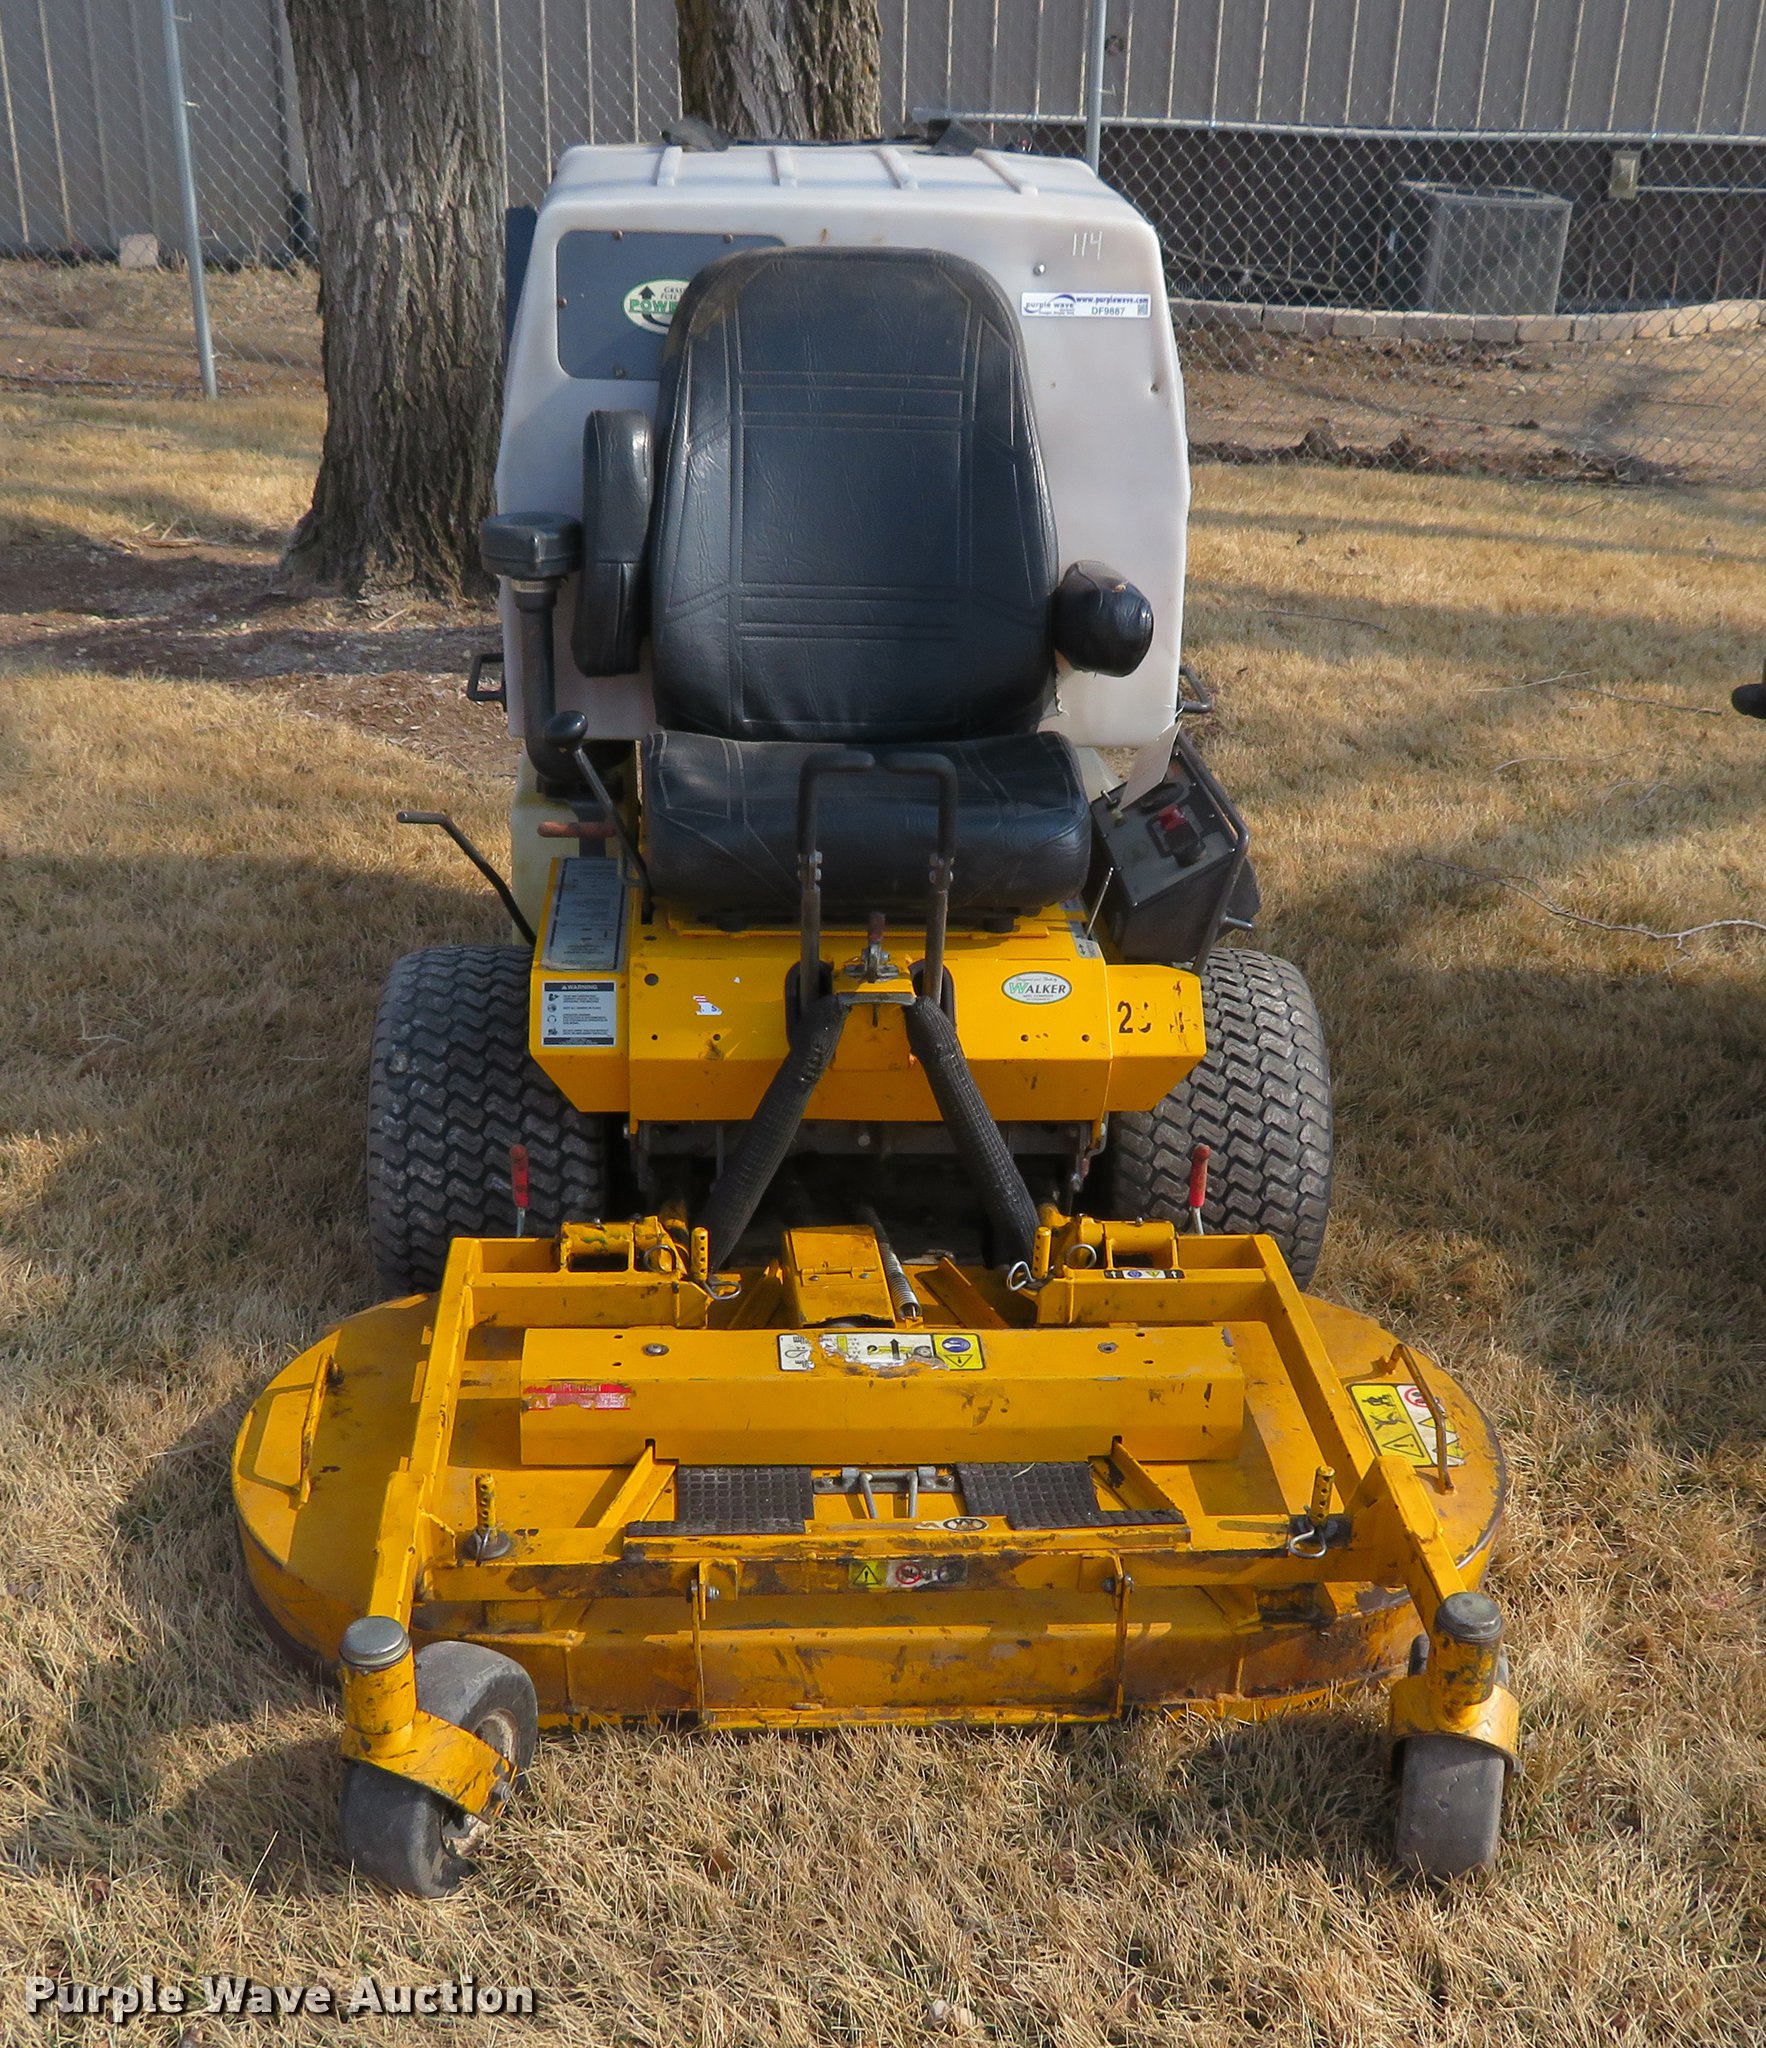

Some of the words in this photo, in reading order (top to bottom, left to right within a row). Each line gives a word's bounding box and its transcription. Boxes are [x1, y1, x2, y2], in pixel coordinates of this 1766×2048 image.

[1072, 231, 1103, 260] 114
[1076, 296, 1149, 305] www.purplewave.com
[1025, 302, 1051, 310] purple
[1009, 982, 1066, 994] WALKER
